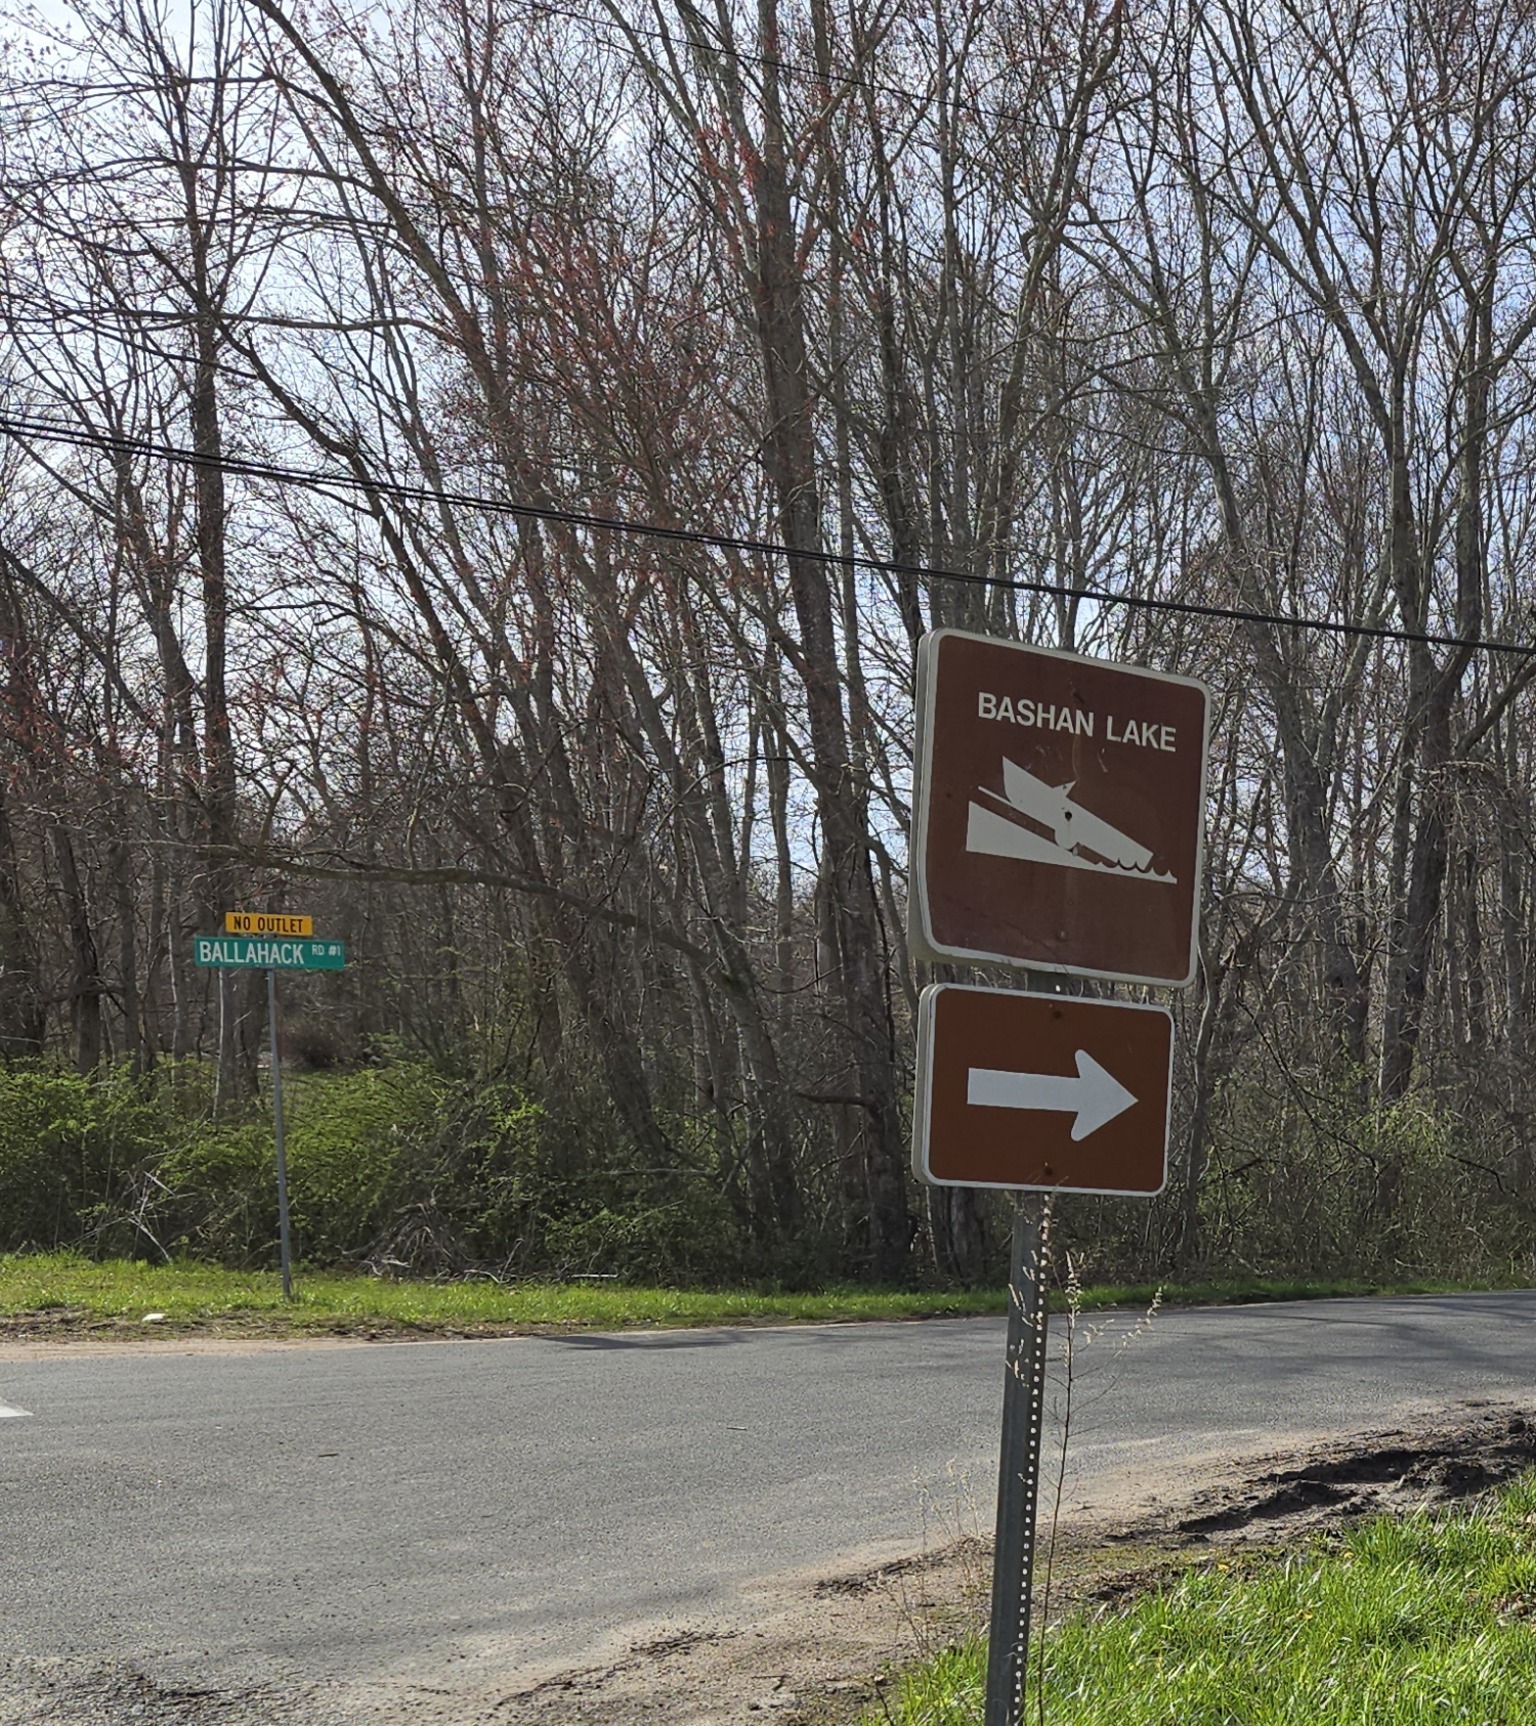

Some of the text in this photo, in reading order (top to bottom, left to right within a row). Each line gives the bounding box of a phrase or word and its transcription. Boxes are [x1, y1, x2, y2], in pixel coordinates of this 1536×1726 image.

[978, 692, 1177, 752] BASHAN LAKE
[234, 915, 304, 933] NO OUTLET
[200, 941, 341, 965] BALLAHACK RD #1
